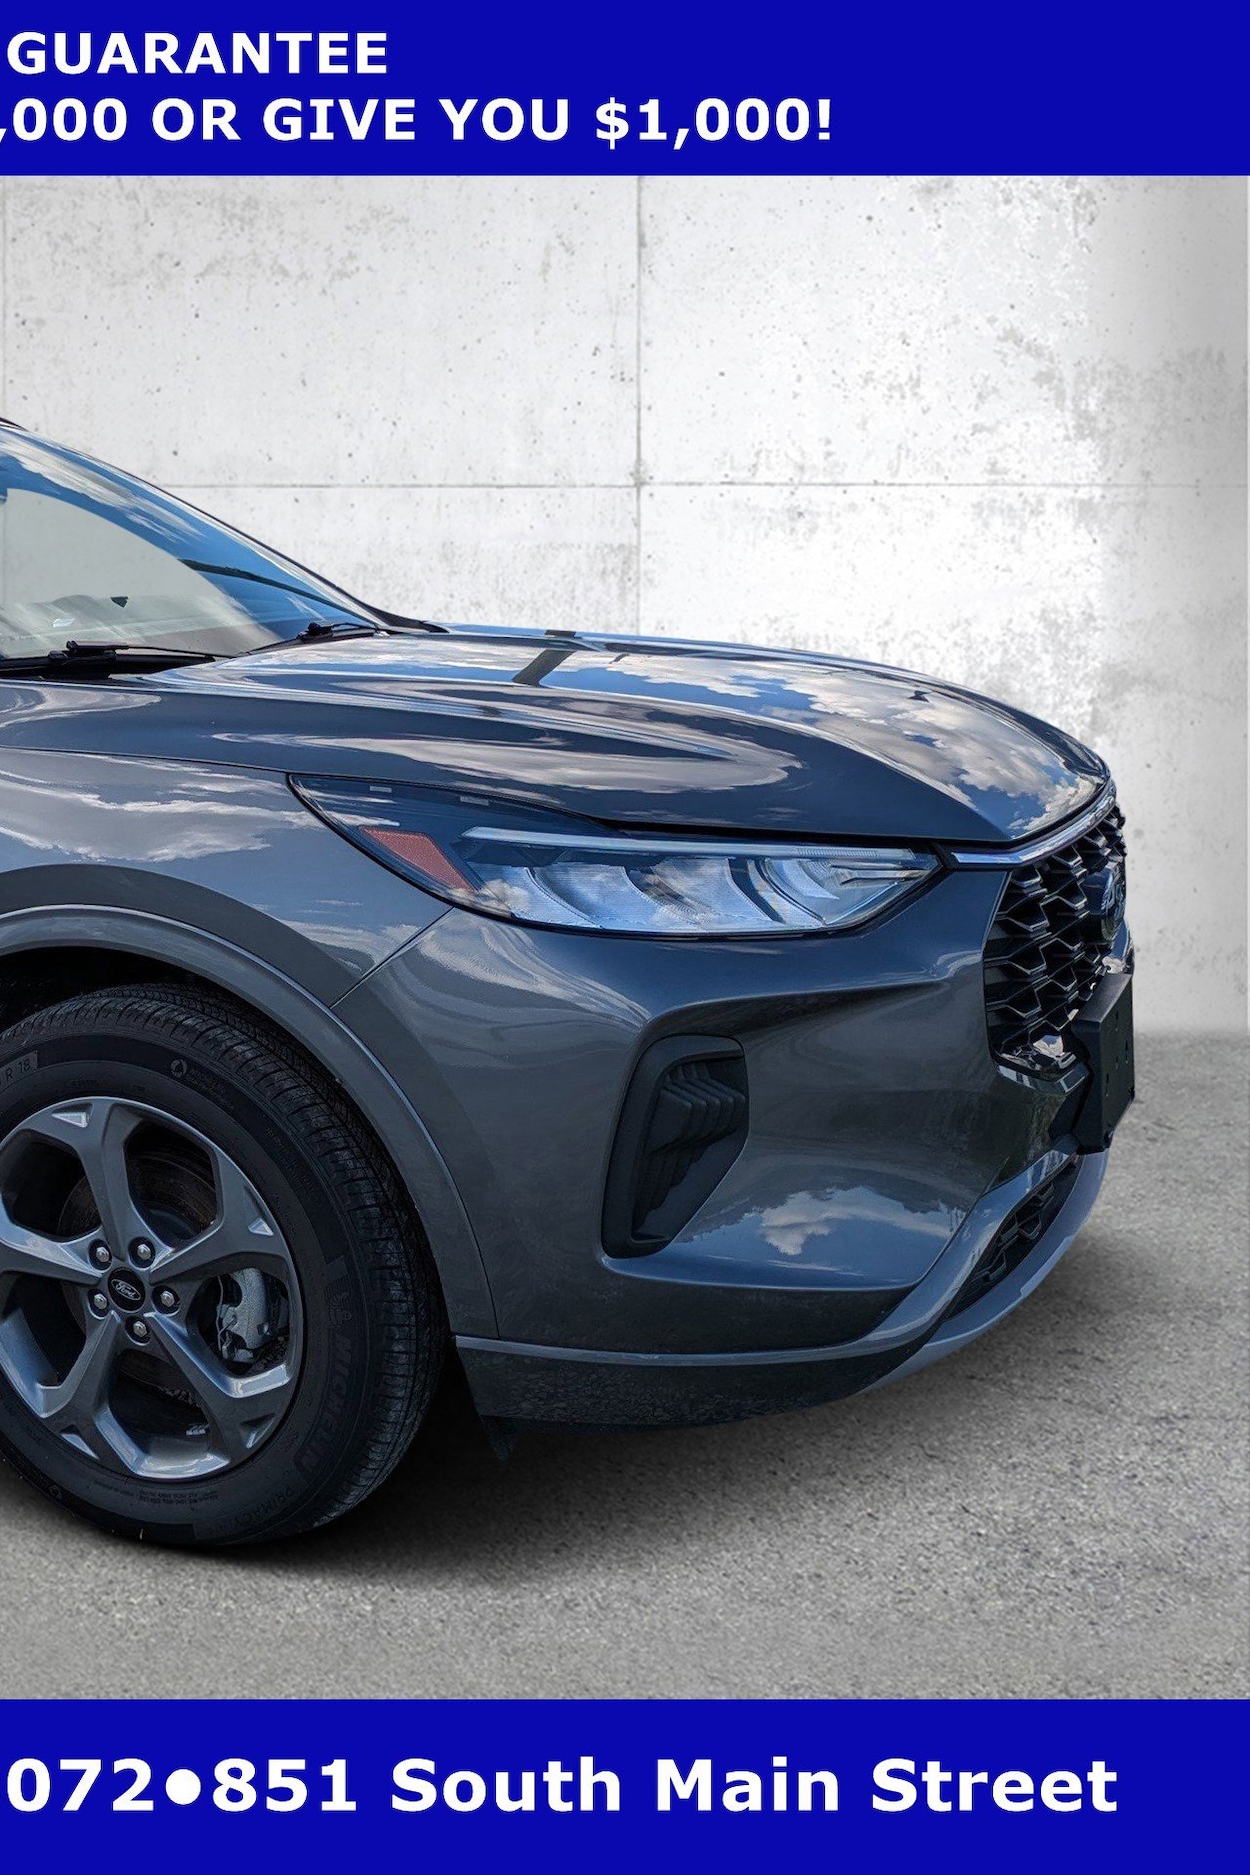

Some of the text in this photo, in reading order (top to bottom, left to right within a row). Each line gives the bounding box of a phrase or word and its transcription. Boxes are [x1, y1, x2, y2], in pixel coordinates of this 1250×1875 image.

[4, 1066, 13, 1081] R
[18, 1057, 32, 1074] 18
[114, 1280, 138, 1299] Ford
